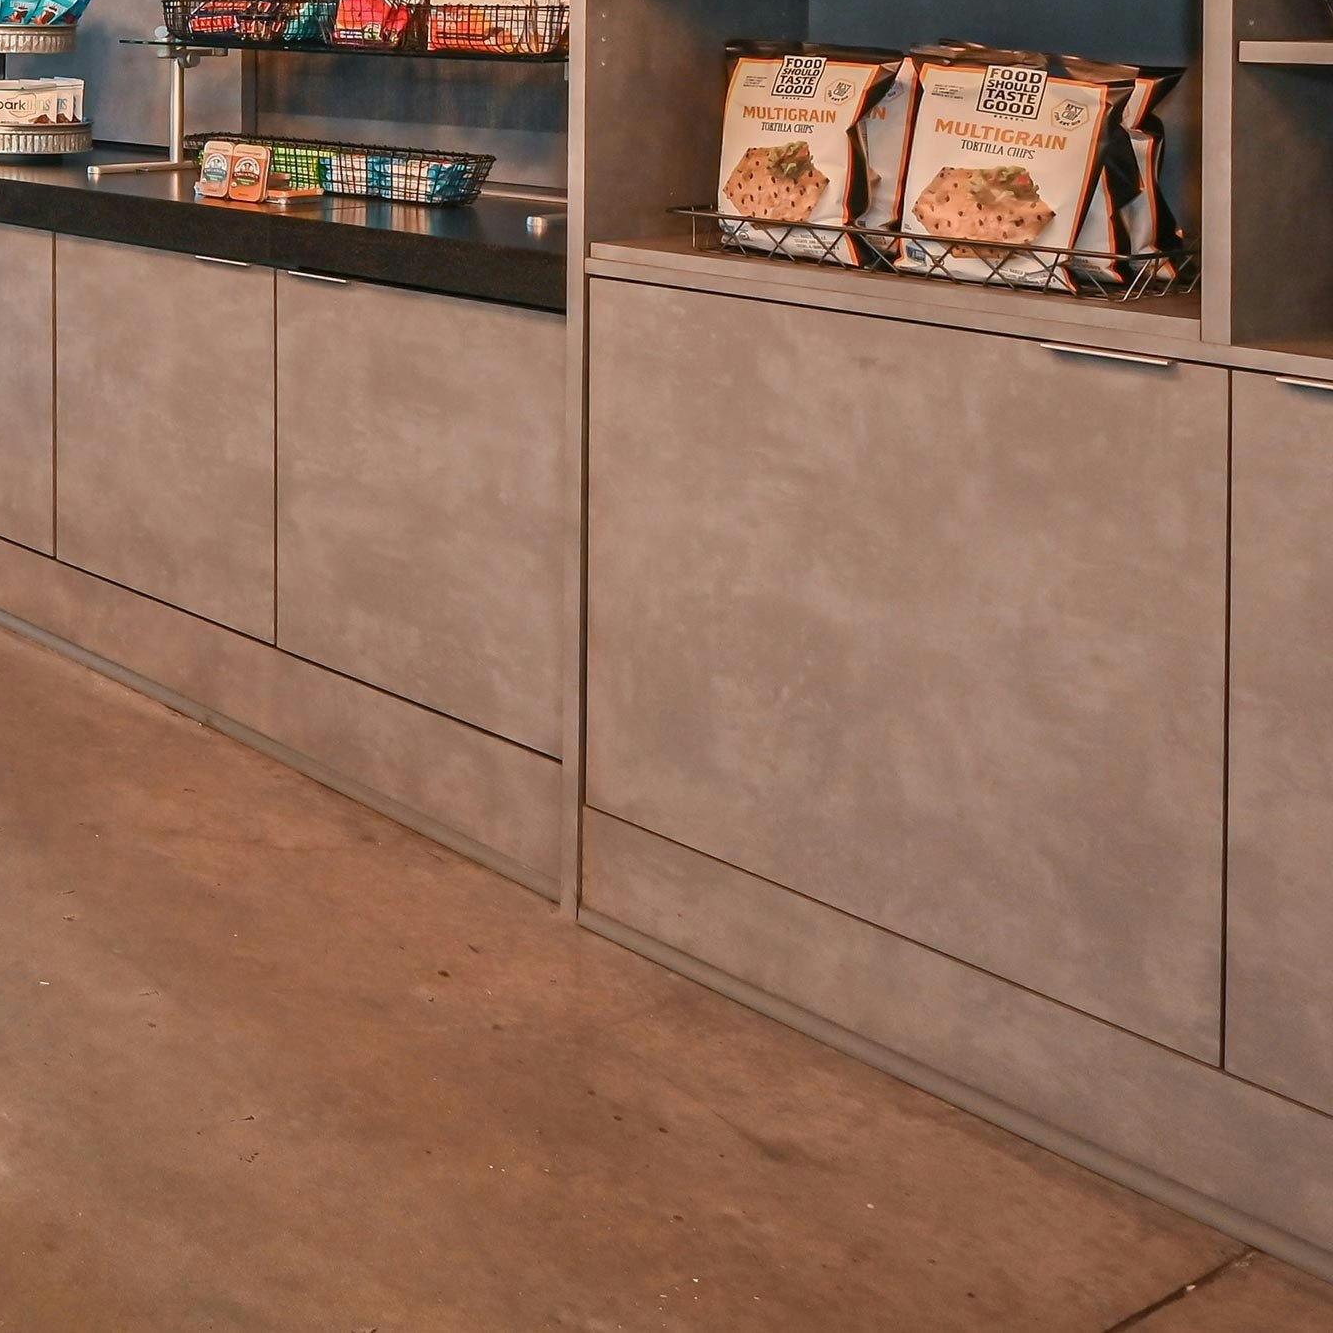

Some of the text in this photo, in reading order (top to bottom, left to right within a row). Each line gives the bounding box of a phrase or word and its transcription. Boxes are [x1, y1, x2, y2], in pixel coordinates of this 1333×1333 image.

[786, 57, 823, 69] FOOD
[780, 75, 816, 86] TASTE
[782, 68, 820, 77] SHOULD
[990, 67, 1043, 84] FOOD
[776, 84, 813, 95] GOOD
[987, 79, 1040, 94] SHOULD
[986, 88, 1037, 105] TASTE
[742, 105, 837, 124] MULTIGRAIN
[983, 99, 1035, 116] GOOD
[761, 121, 815, 134] TORTILLA CHIPS
[935, 118, 1068, 151] MULTIGRAIN
[961, 139, 1036, 160] TORTILLA CHIPS
